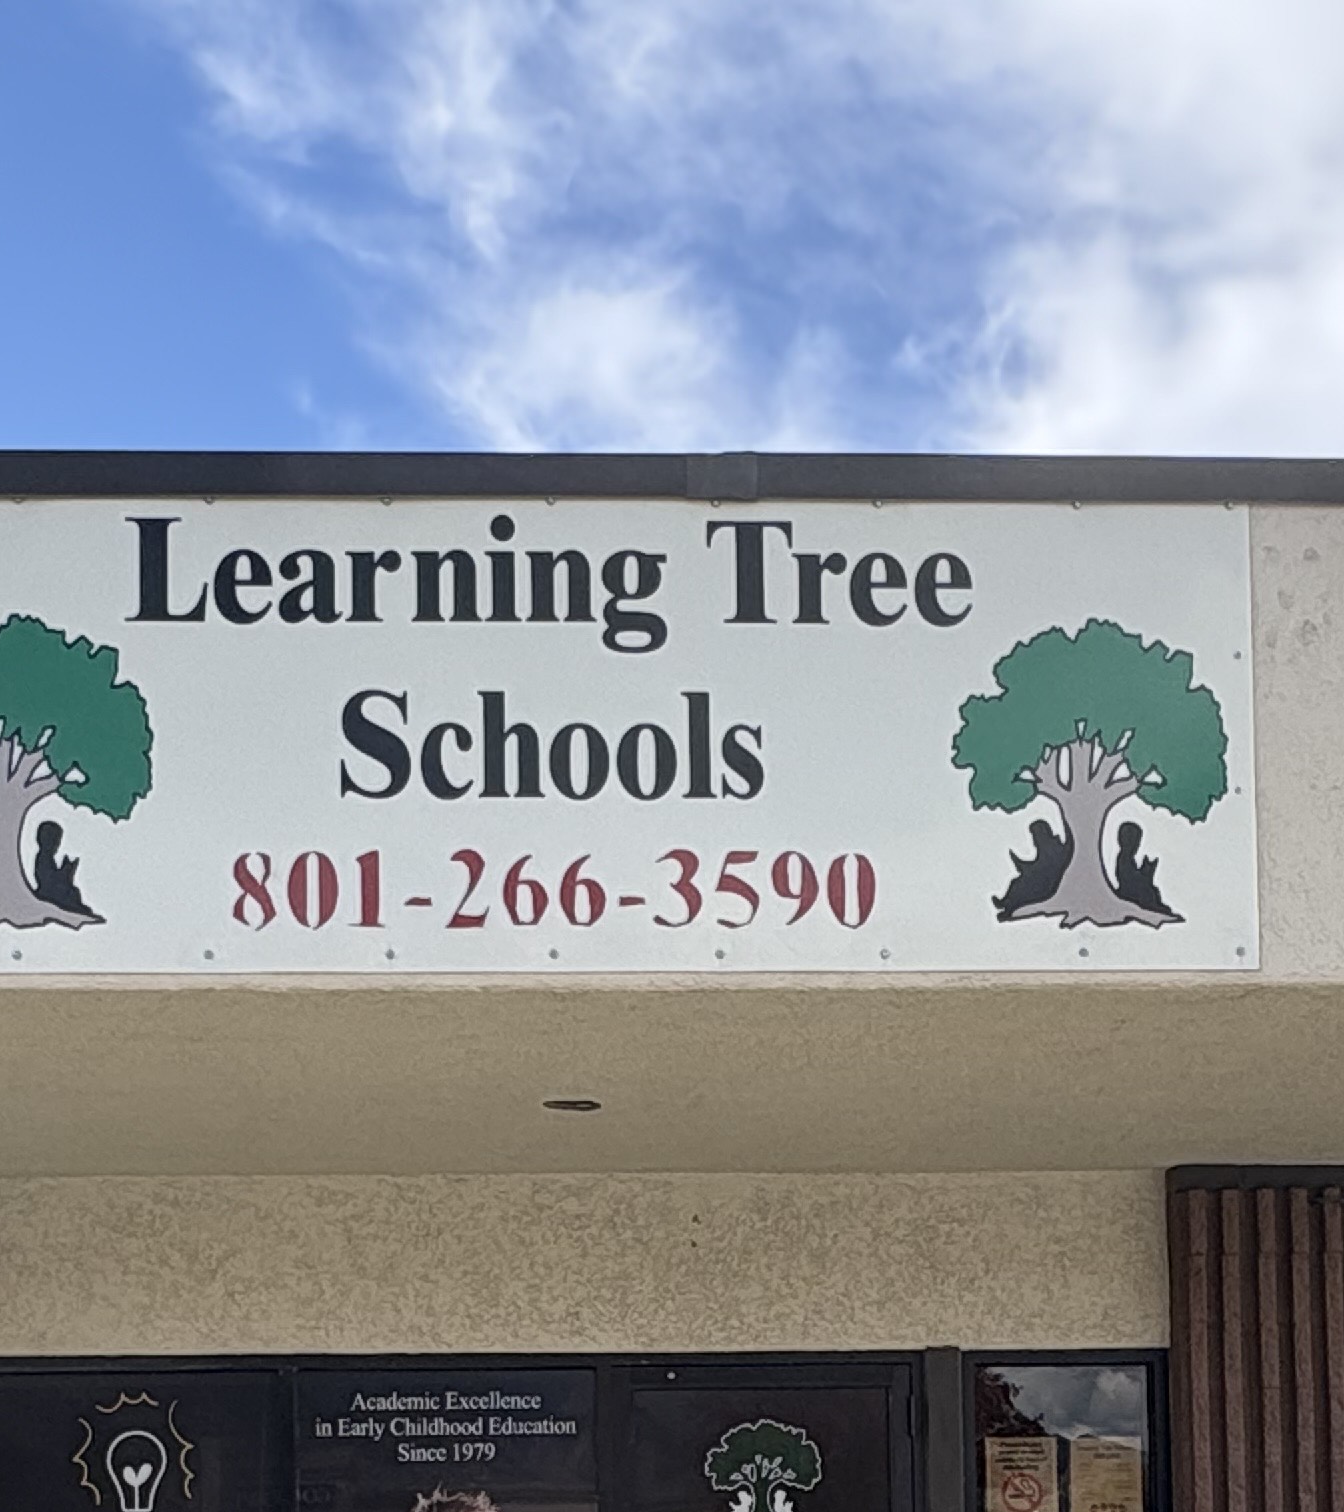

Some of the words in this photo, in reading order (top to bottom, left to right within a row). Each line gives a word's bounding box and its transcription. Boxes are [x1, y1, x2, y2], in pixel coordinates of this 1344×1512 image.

[124, 514, 668, 655] Learning
[706, 519, 974, 628] Tree
[340, 688, 765, 801] Schools
[231, 848, 877, 932] 801-266-3590
[315, 1417, 333, 1437] in
[338, 1417, 386, 1441] Early
[390, 1416, 484, 1436] Childhood
[488, 1415, 577, 1436] Education
[350, 1391, 441, 1411] Academic
[444, 1390, 542, 1410] Excellence
[397, 1442, 447, 1462] Since
[453, 1442, 496, 1462] 1979
